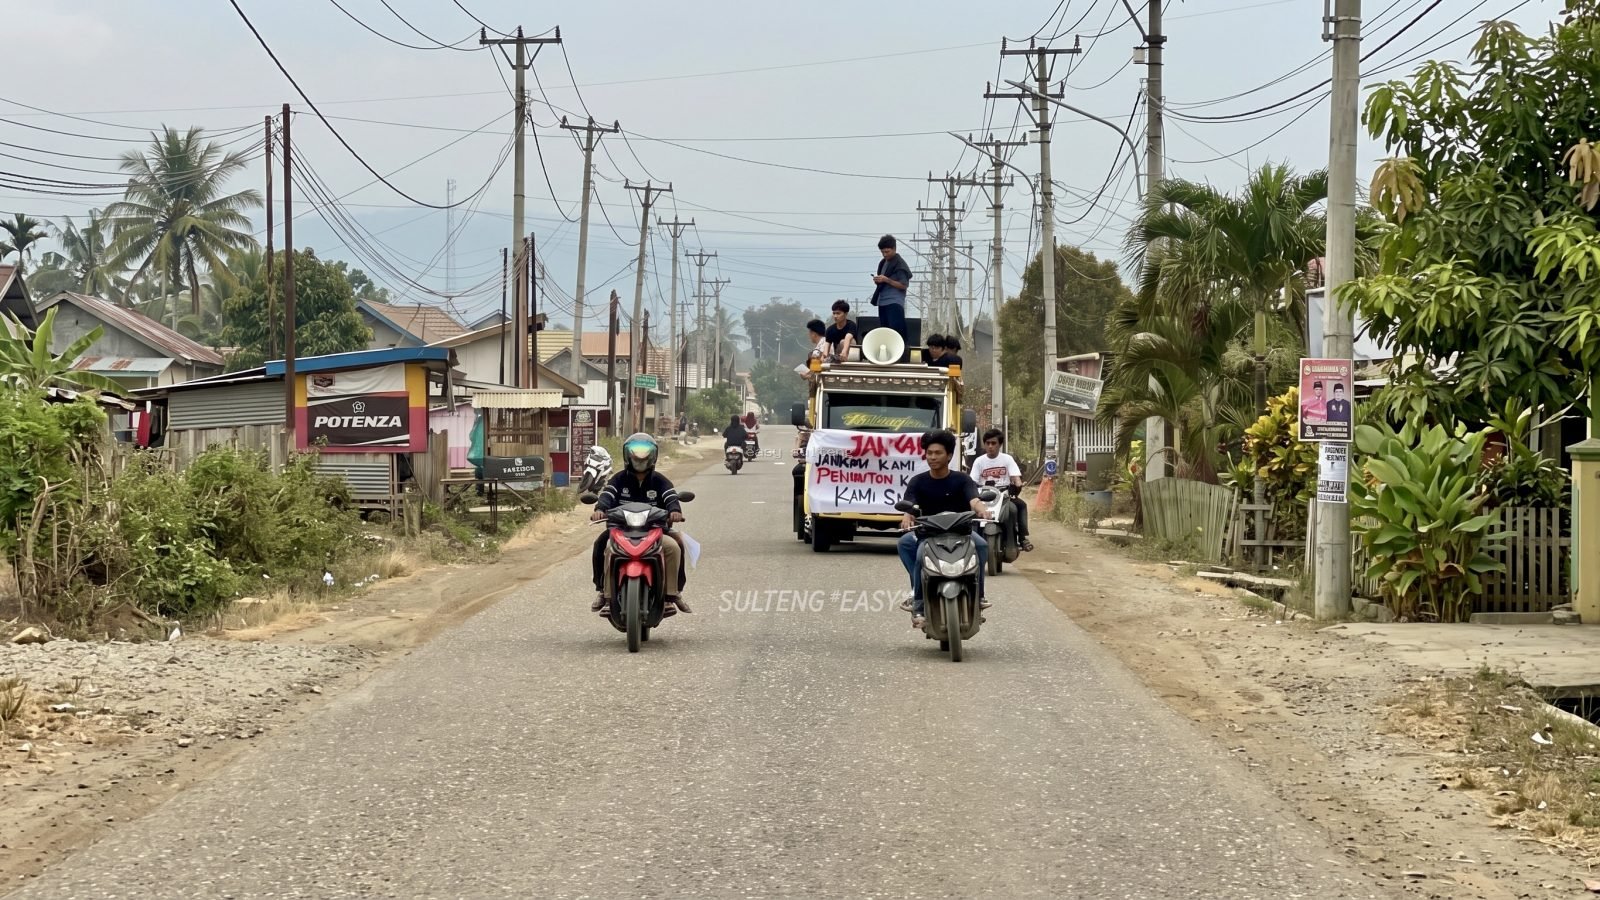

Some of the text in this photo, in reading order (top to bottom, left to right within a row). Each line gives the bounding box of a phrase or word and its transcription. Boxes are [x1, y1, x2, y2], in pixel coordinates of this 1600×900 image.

[314, 415, 402, 428] POTENZA
[879, 459, 915, 471] KAMI
[835, 486, 876, 507] KAMI
